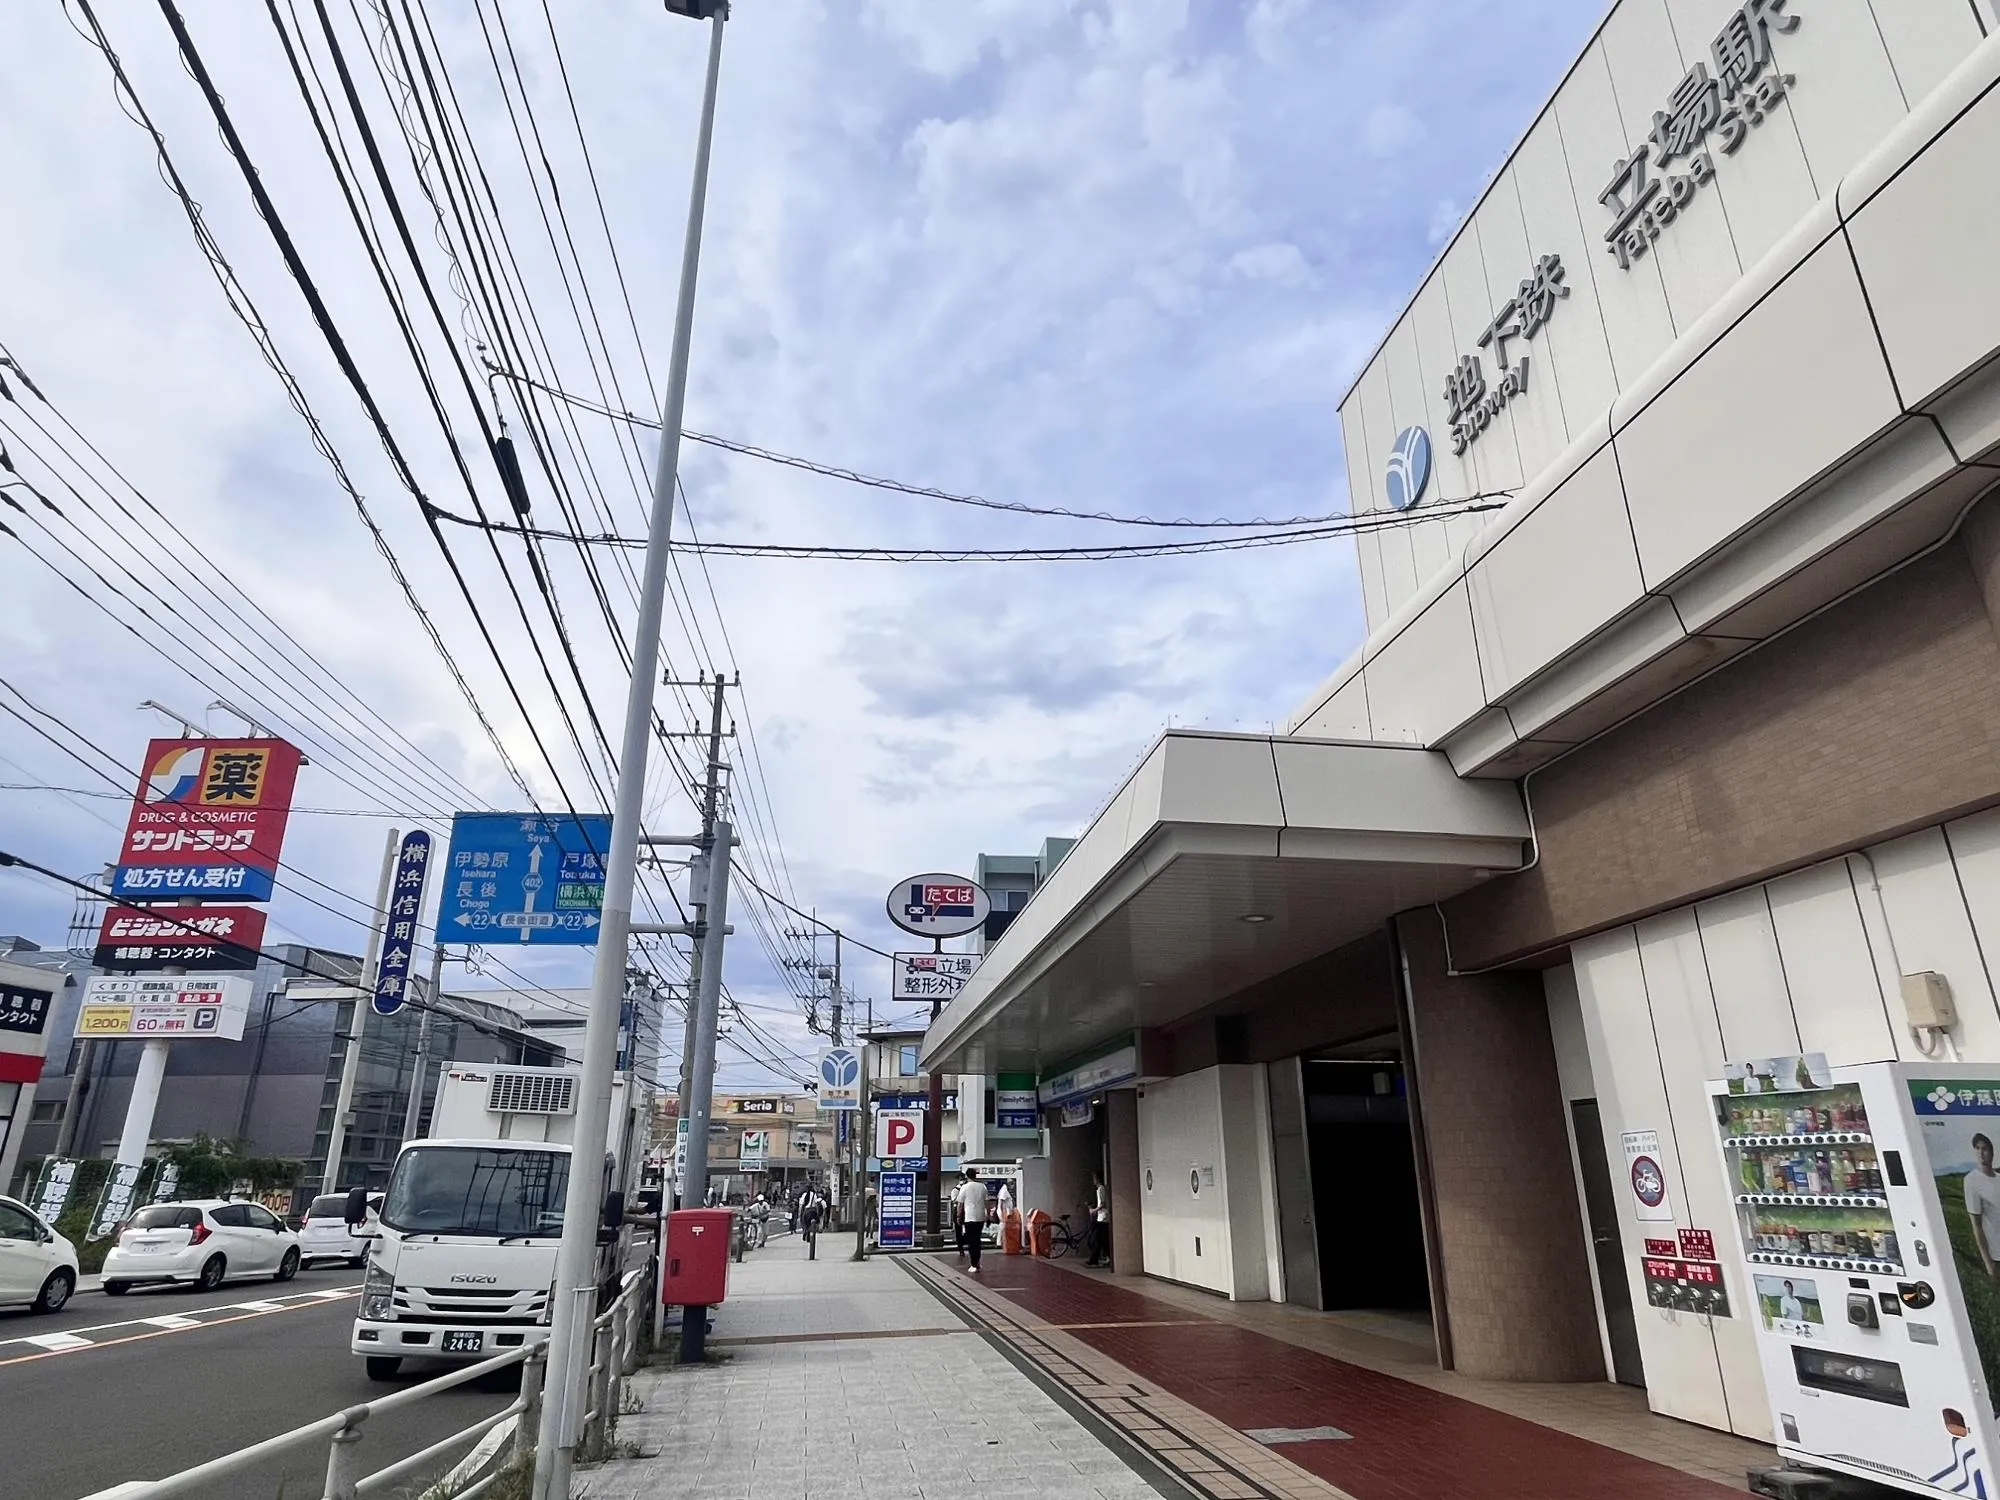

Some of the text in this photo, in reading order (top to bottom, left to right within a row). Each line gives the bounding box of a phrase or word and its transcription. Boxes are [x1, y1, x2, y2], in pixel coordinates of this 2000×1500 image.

[1443, 0, 1801, 424] 地下鉄 立場駅
[1449, 72, 1797, 456] Subway Tateba Sta.
[205, 753, 263, 800] 薬
[138, 811, 258, 823] DRUG & COSMETIC
[131, 829, 256, 851] サンドラッグ
[455, 851, 509, 869] 伊勢原
[122, 867, 246, 888] 処方せん受付
[462, 869, 497, 878] Isehara
[456, 881, 497, 898] 長後
[525, 877, 541, 888] 402
[926, 887, 972, 902] たてば
[459, 899, 490, 910] Chogo
[109, 917, 235, 937] ビジョンメガネ
[379, 844, 428, 997] 横浜信用金庫
[474, 914, 488, 926] 22
[505, 915, 550, 926] 長後街道
[566, 914, 581, 926] 22
[939, 958, 973, 975] 立場
[99, 983, 129, 991] くすり
[743, 1100, 772, 1111] Seria
[998, 1095, 1035, 1105] FamilyMart
[888, 1119, 915, 1155] P
[450, 1274, 498, 1284] ISUZU
[450, 1338, 480, 1351] 24-82
